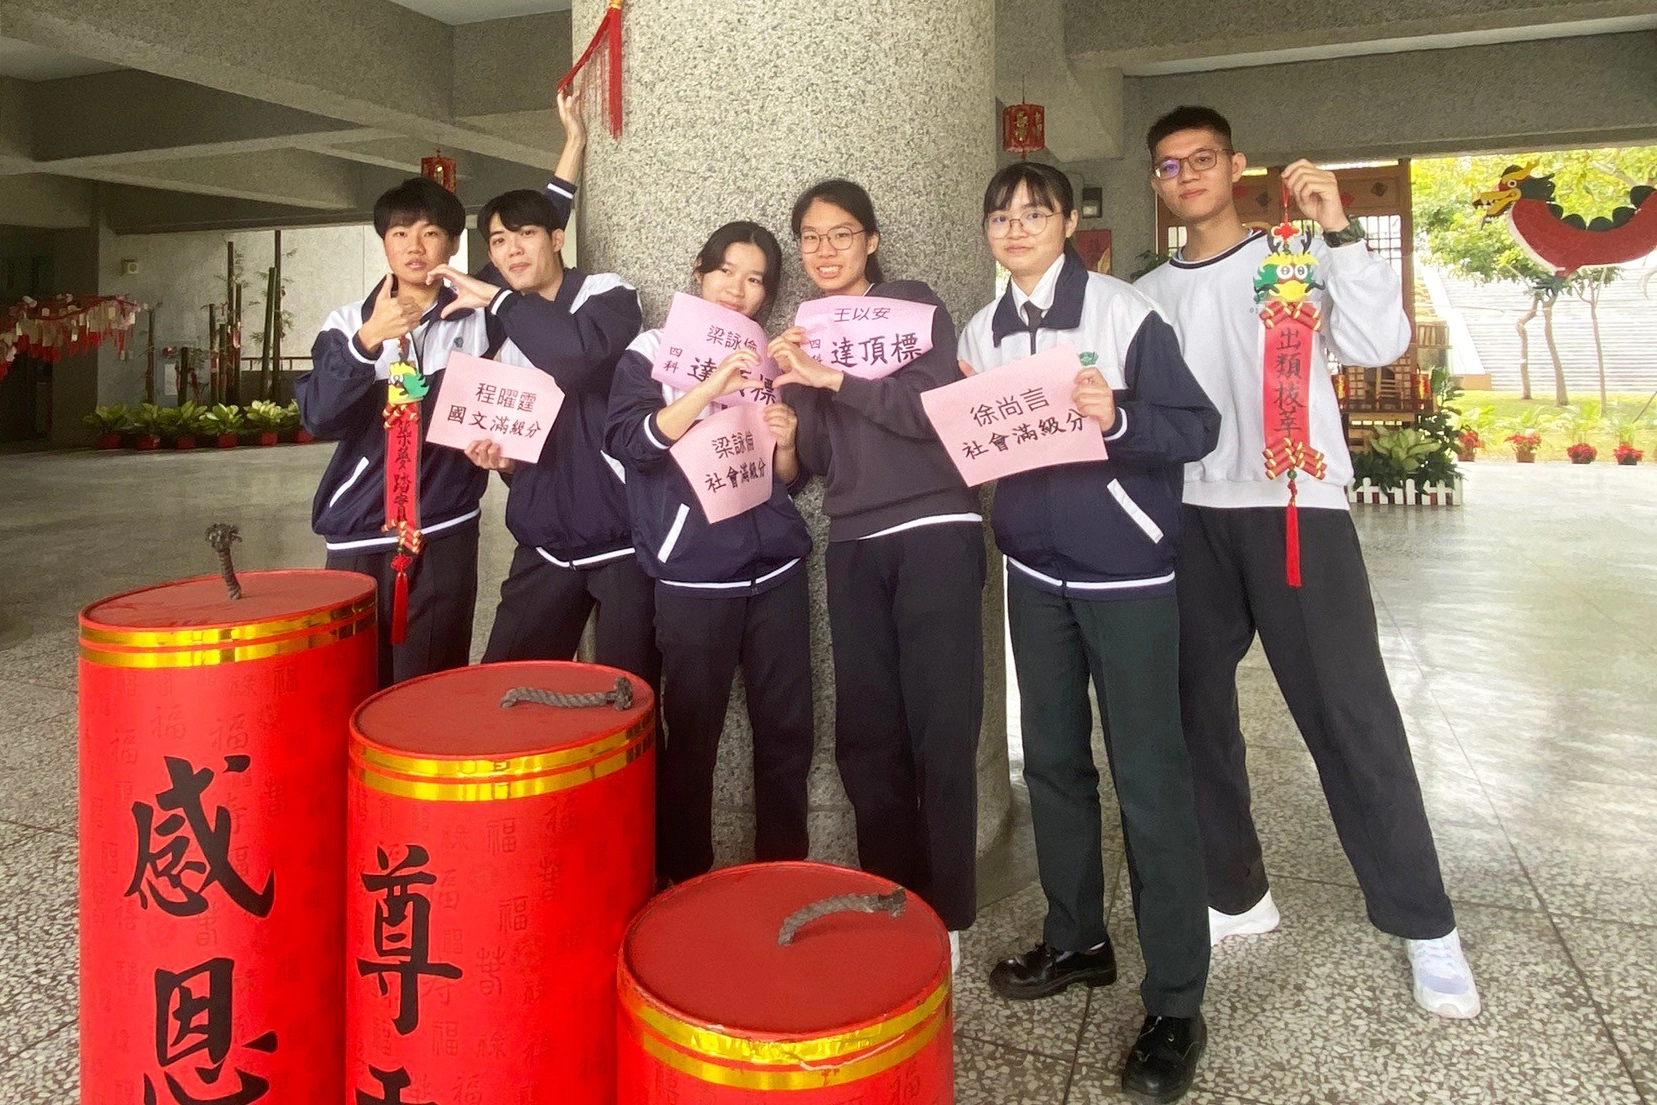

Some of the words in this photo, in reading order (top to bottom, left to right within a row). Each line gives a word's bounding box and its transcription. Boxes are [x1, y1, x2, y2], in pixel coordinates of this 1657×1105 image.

[833, 307, 891, 323] 王以安
[663, 346, 684, 374] 四科
[830, 332, 922, 368] 達頂標
[475, 382, 537, 413] 程曜霆
[686, 357, 777, 405] 達標
[447, 404, 542, 439] 國文滿級分
[970, 387, 1050, 428] 徐尚言
[961, 408, 1088, 460] 社會滿級分
[704, 457, 767, 494] 社會滿級分
[123, 755, 277, 1105] 感恩
[355, 843, 464, 1105] 尊
